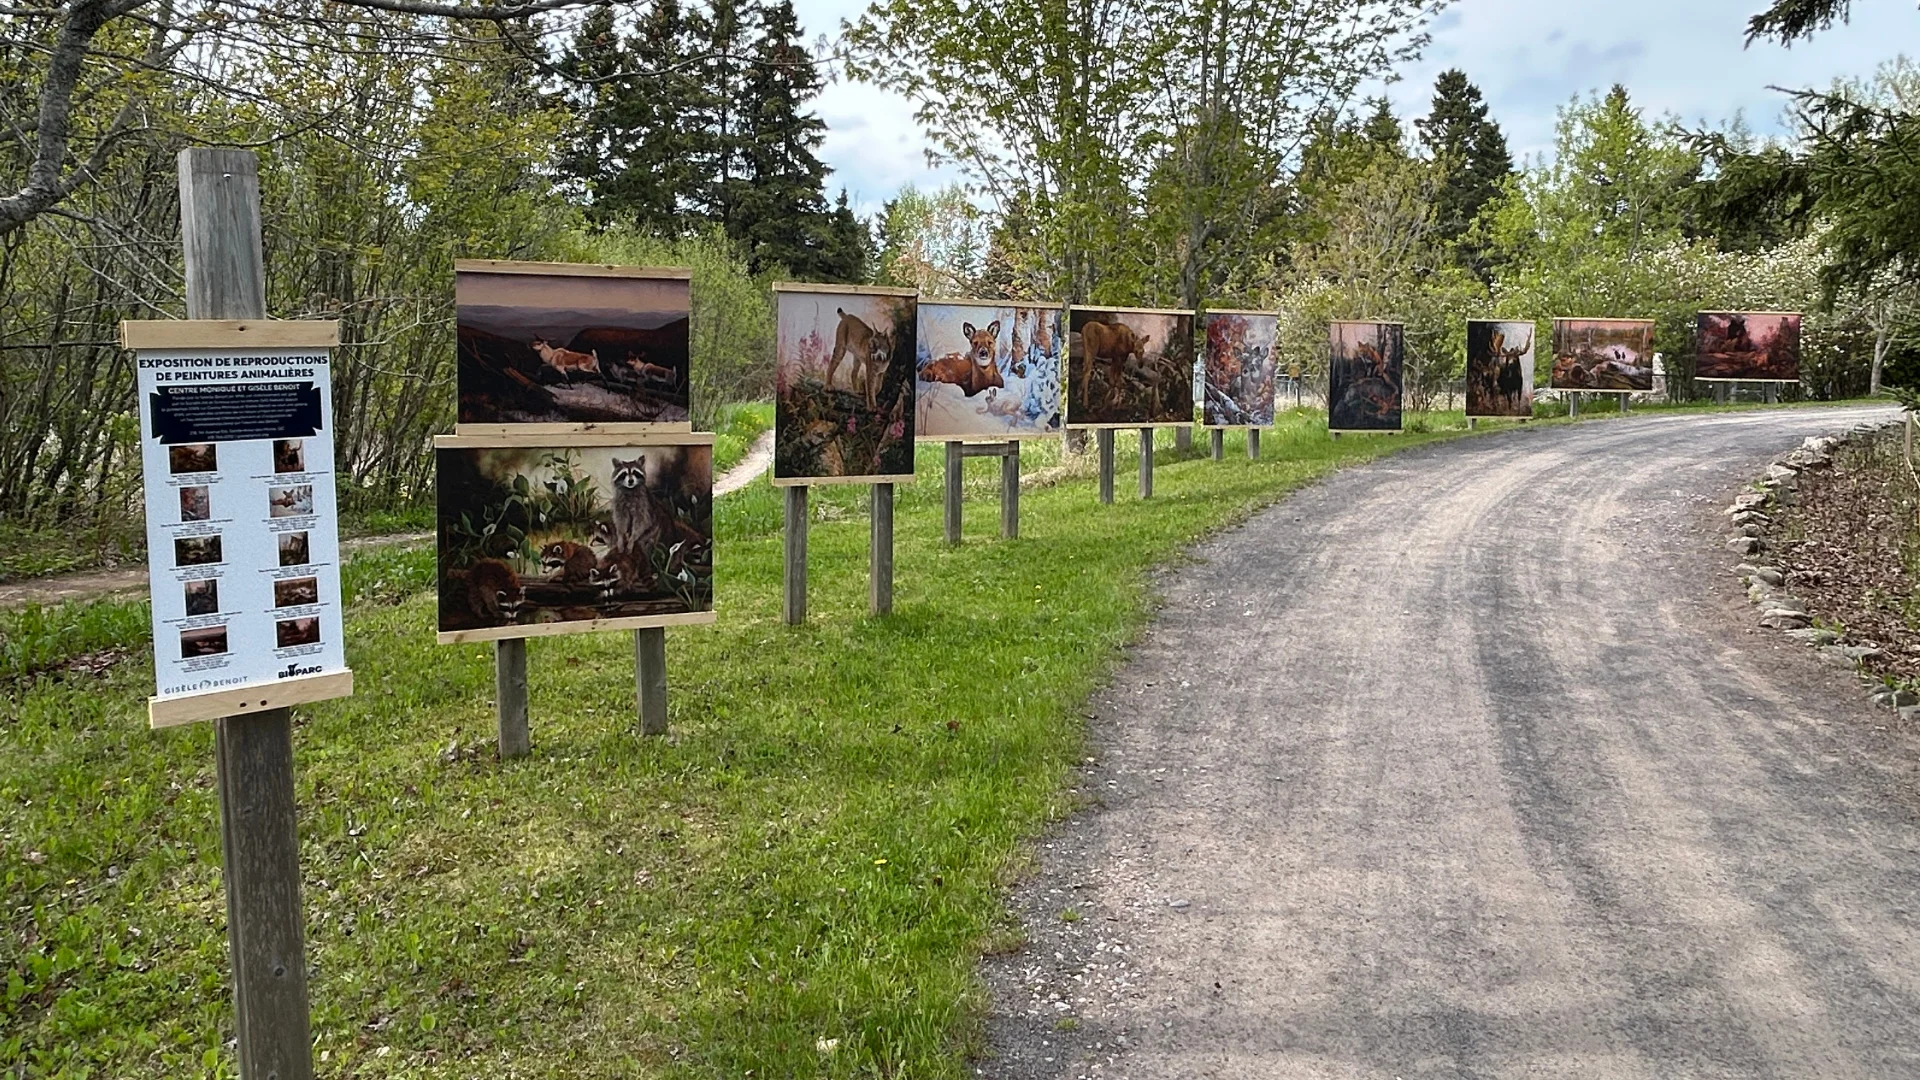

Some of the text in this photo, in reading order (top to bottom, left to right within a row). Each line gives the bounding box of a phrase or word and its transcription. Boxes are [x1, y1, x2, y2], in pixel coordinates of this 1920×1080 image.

[139, 355, 328, 369] EXPOSITION DE REPRODUCTIONS
[156, 366, 315, 381] DE PEINTURES ANIMALIÈRES
[168, 387, 198, 395] CENTRE
[200, 386, 236, 394] MONIQUE
[237, 385, 246, 393] ET
[273, 383, 300, 391] BENOIT
[278, 664, 323, 679] BIOPARC
[164, 675, 249, 695] GISÈLE BENOIT
